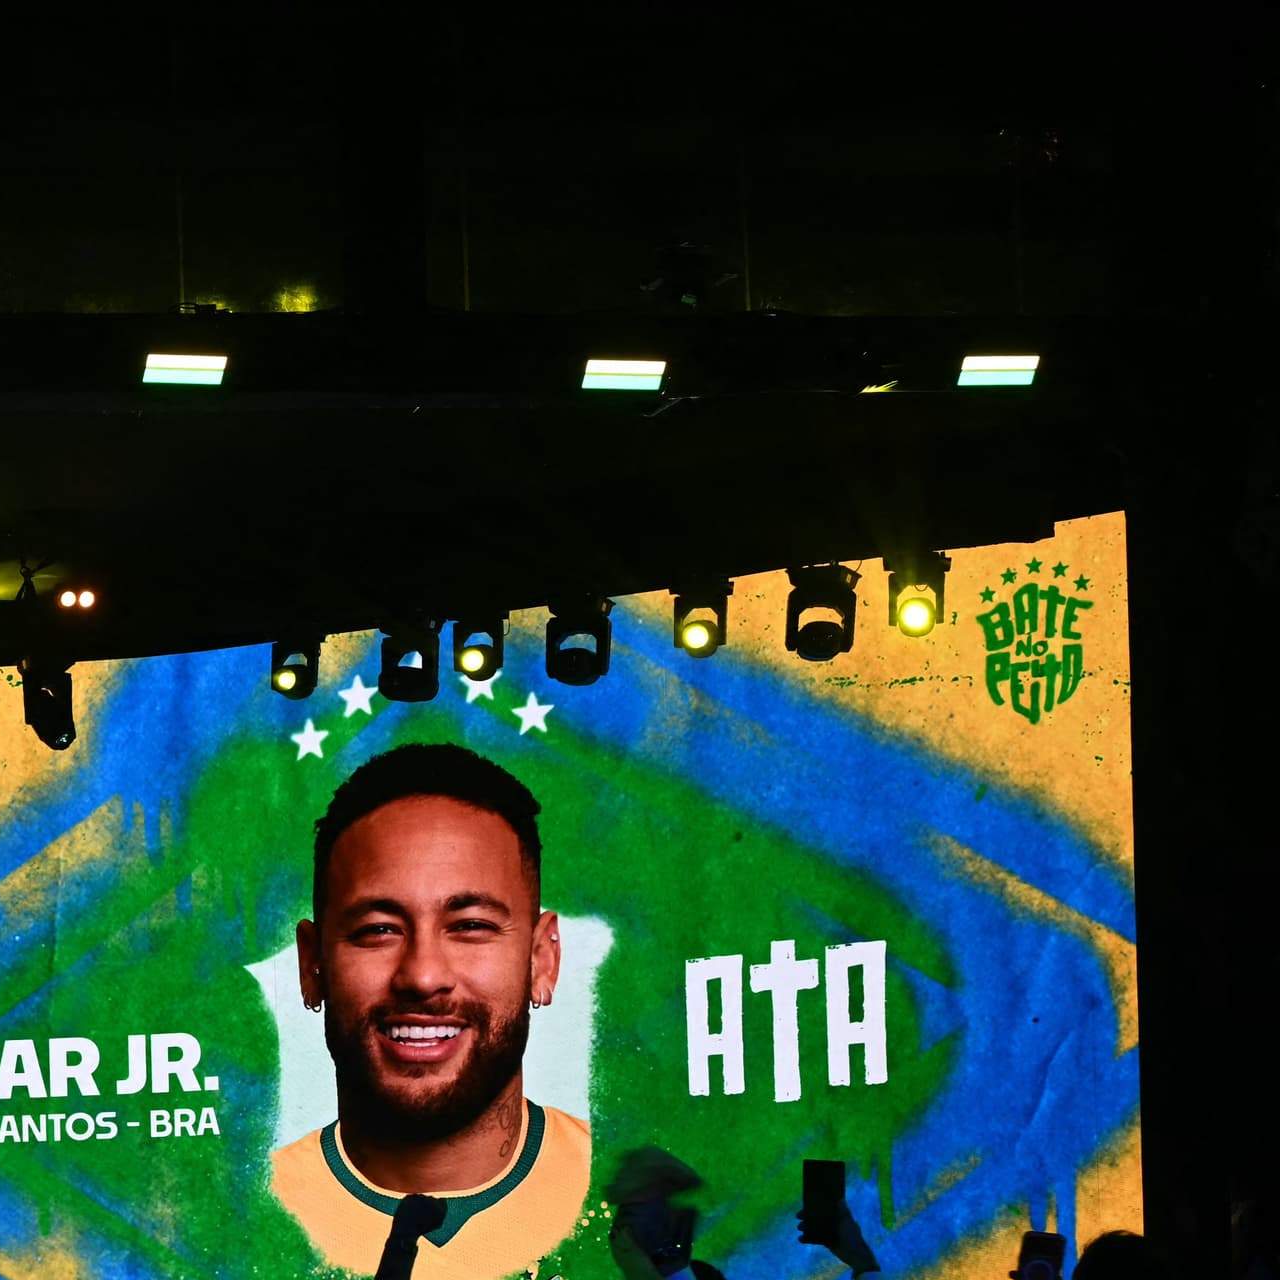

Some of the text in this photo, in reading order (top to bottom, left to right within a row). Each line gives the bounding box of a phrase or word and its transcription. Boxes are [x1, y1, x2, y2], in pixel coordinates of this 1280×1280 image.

[976, 583, 1093, 651] BATE
[1016, 634, 1048, 657] NO
[986, 643, 1082, 724] PEITO
[685, 939, 888, 1102] ATA
[116, 1032, 220, 1096] JR.
[150, 1107, 220, 1138] BRA
